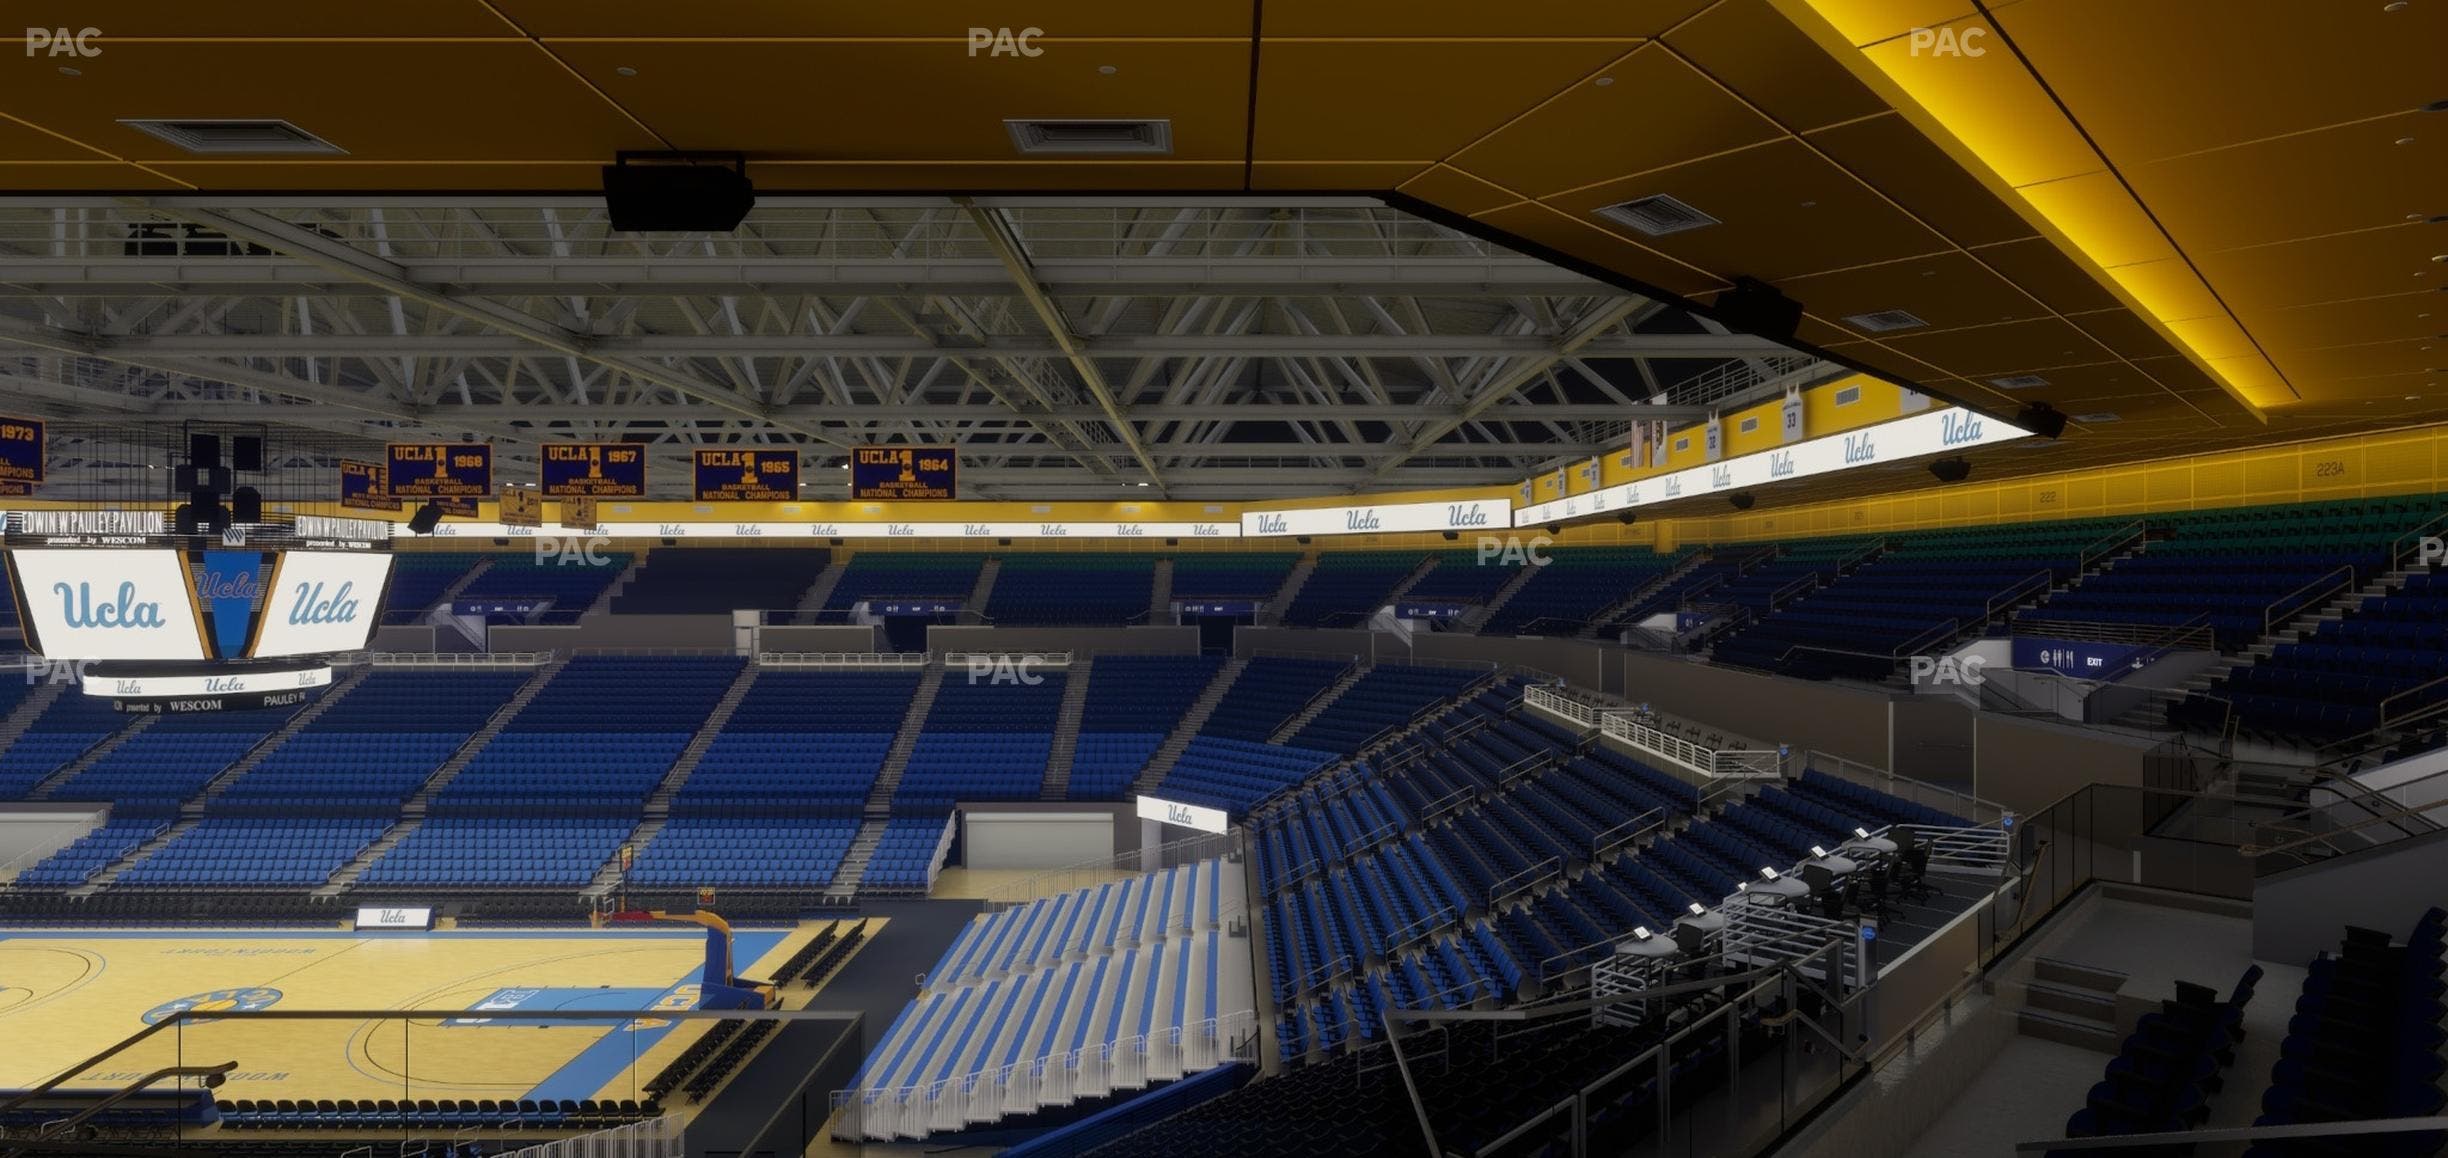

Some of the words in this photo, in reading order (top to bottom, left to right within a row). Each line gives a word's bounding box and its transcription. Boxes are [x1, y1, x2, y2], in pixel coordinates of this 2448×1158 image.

[1787, 412, 1796, 429] 33
[0, 424, 34, 442] 1973
[1942, 410, 1983, 446] Ucla
[549, 446, 587, 461] UCLA
[608, 450, 637, 463] 1967
[1844, 432, 1876, 464] Ucla
[394, 446, 433, 461] UCLA
[453, 455, 483, 468] 1968
[702, 452, 741, 466] UCLA
[761, 461, 790, 473] 1965
[860, 450, 898, 464] UCLA
[919, 458, 949, 471] 1964
[1771, 450, 1794, 478] Ucla
[342, 463, 366, 476] UCLA
[2317, 462, 2345, 477] 223A
[1713, 465, 1731, 489] Ucla
[395, 485, 432, 494] NATIONAL
[438, 485, 483, 494] CHAMPIONS
[550, 485, 586, 494] NATIONAL
[592, 485, 637, 494] CHAMPIONS
[702, 490, 739, 500] NATIONAL
[745, 490, 790, 500] CHAMPIONS
[860, 488, 897, 498] NATIONAL
[903, 488, 948, 498] CHAMPIONS
[2040, 491, 2056, 503] 222
[1346, 509, 1380, 530] Ucla
[1448, 504, 1487, 526] Ucla
[22, 511, 56, 534] EDWIN
[58, 511, 69, 534] W
[71, 511, 111, 534] PAULEY
[113, 511, 163, 534] PAVILION
[1258, 514, 1287, 533] Ucla
[507, 525, 533, 536] Ucla
[659, 525, 686, 536] Ucla
[735, 525, 762, 536] Ucla
[812, 525, 837, 536] Ucla
[888, 525, 914, 536] Ucla
[963, 525, 990, 536] Ucla
[1040, 525, 1067, 536] Ucla
[1117, 524, 1143, 536] Ucla
[1193, 524, 1219, 536] Ucla
[86, 536, 97, 545] by
[102, 536, 146, 544] WESCOM
[53, 581, 166, 629] Ucla
[288, 581, 358, 625] Ucla
[2087, 656, 2103, 667] EXIT
[117, 680, 141, 694] Ucla
[205, 677, 246, 692] Ucla
[154, 703, 161, 713] by
[170, 699, 222, 711] WESCOM
[264, 693, 298, 707] PAULEY
[1168, 804, 1193, 825] Ucla
[380, 909, 406, 923] Ucla
